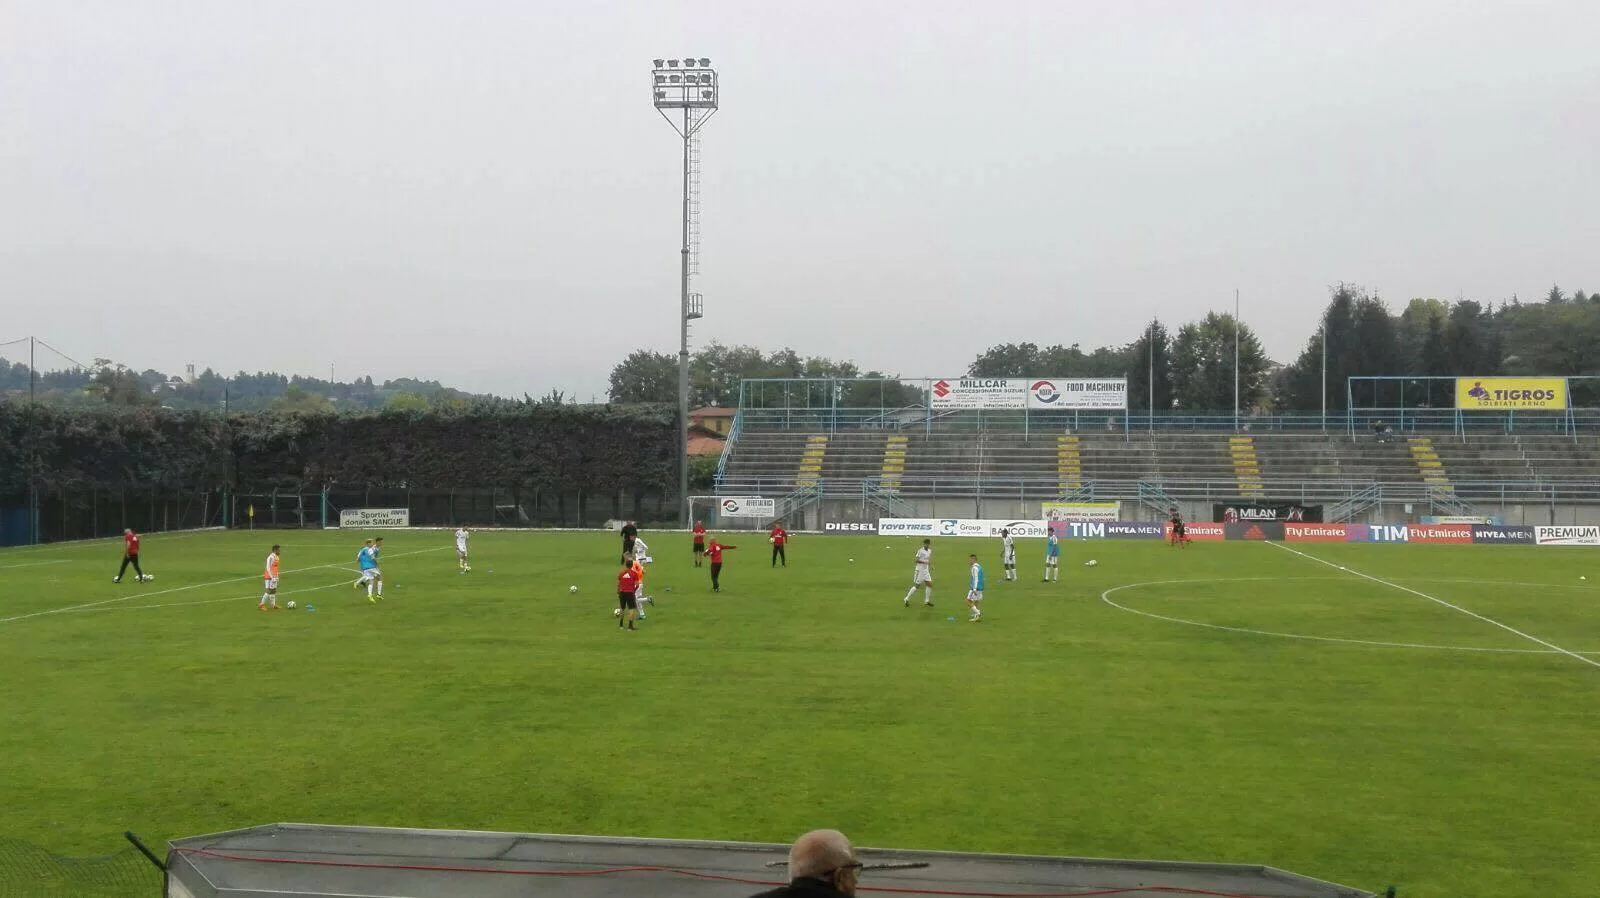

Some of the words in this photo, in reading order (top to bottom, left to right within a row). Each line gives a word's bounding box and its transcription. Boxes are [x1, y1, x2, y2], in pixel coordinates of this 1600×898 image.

[960, 380, 1007, 388] MILLCAR
[1066, 383, 1083, 391] FOOD
[1086, 383, 1125, 391] MACHINERY
[1494, 389, 1555, 400] TIGROS
[360, 511, 389, 519] Sportivi
[1240, 508, 1276, 517] MILAN
[960, 523, 981, 531] Group
[1070, 522, 1105, 537] TIM
[1183, 526, 1224, 535] Emirates
[1286, 527, 1302, 537] Fly
[1304, 527, 1346, 536] Emirates
[1370, 525, 1409, 541] TIM
[1410, 528, 1426, 538] Fly
[1428, 528, 1471, 538] Emirates
[1540, 528, 1597, 537] PREMIUM
